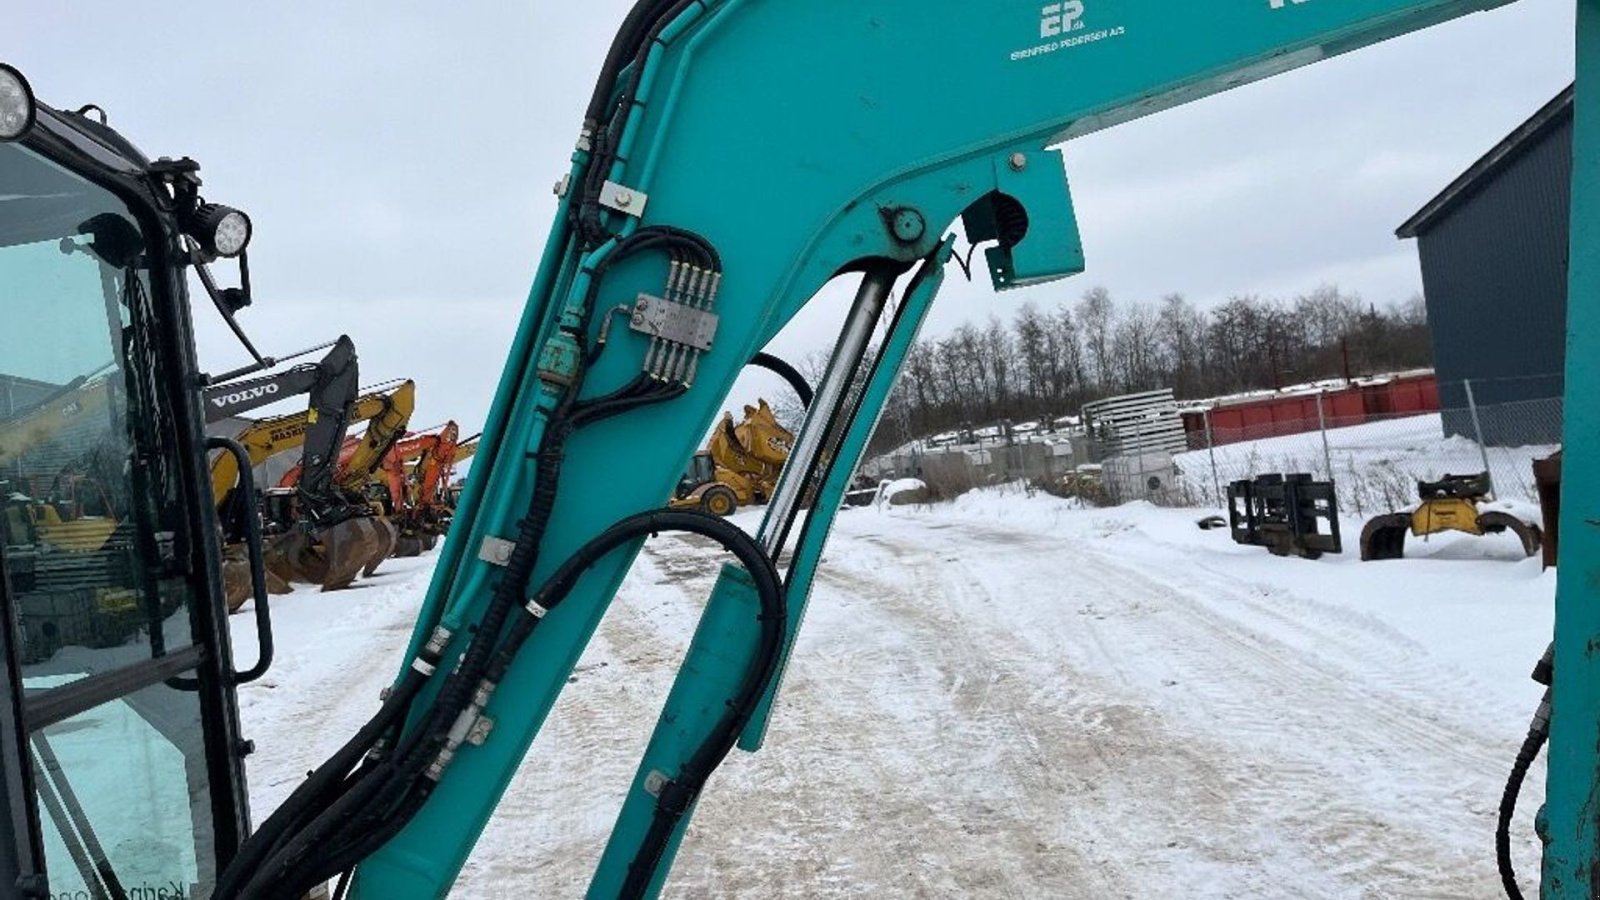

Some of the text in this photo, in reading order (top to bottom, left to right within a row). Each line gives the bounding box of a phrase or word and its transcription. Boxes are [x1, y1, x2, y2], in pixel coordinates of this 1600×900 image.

[1060, 30, 1107, 48] PEDERSEN
[1109, 26, 1125, 37] A/S
[211, 383, 279, 407] VOLVO
